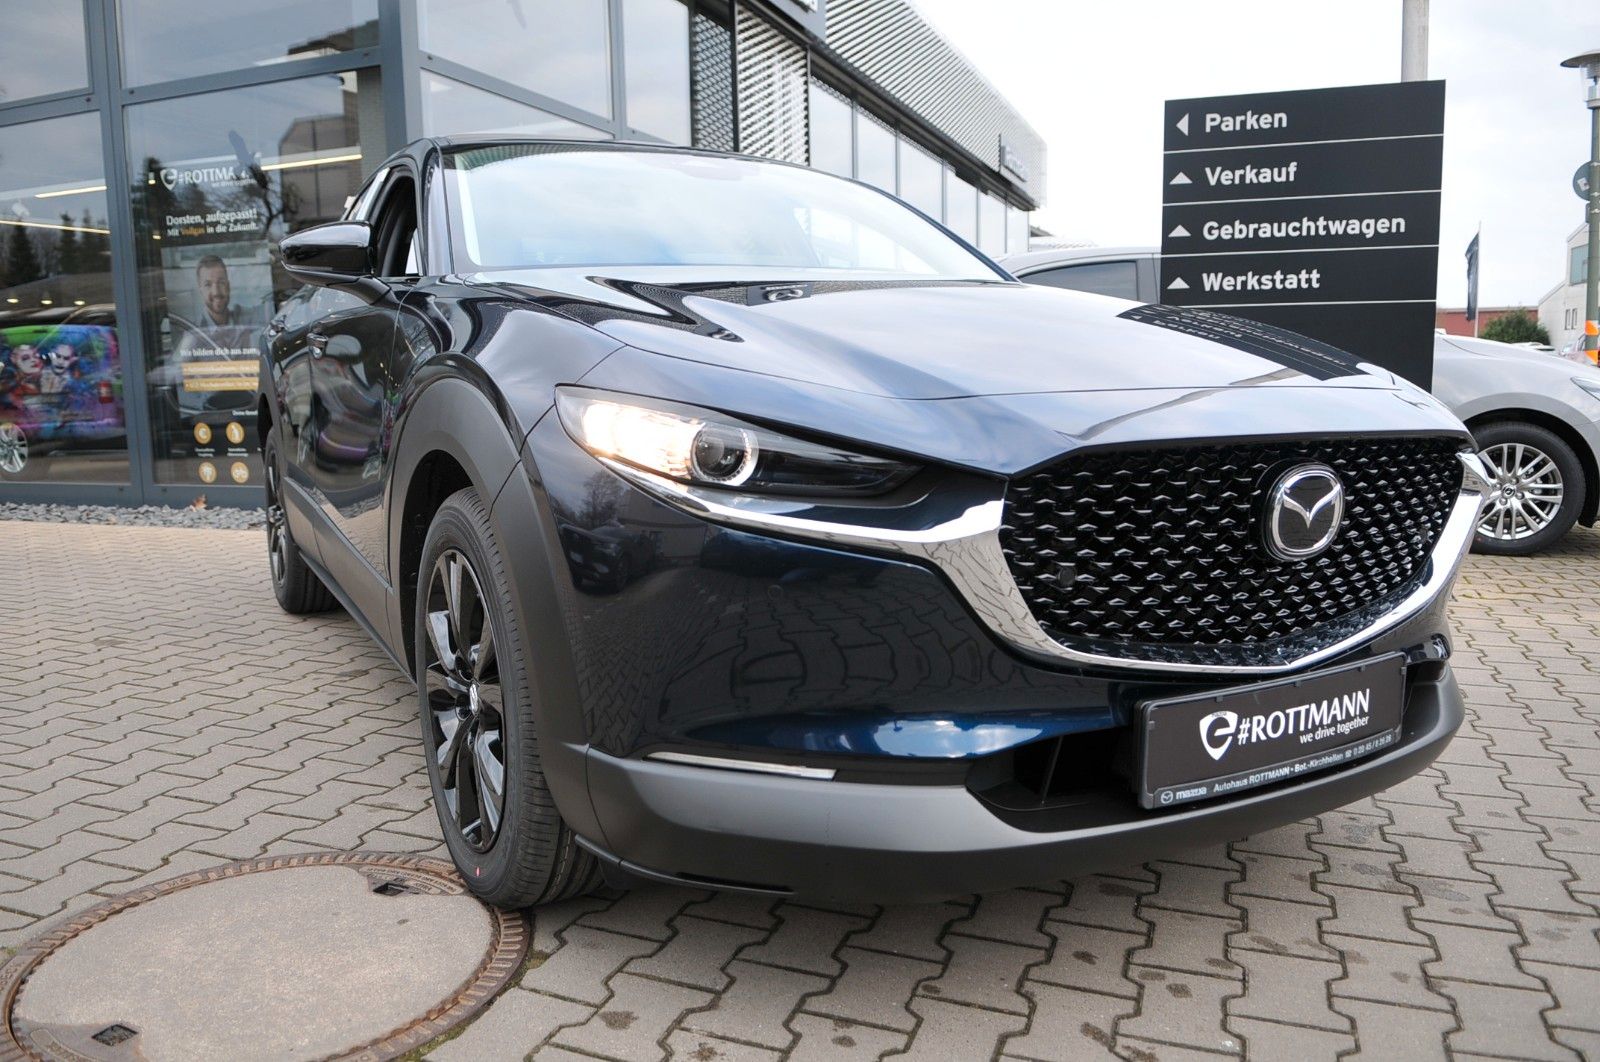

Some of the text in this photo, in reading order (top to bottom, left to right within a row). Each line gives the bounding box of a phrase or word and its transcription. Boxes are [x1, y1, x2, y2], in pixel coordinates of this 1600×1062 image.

[1205, 110, 1287, 132] Parken
[1205, 162, 1298, 186] Verkauf
[165, 207, 258, 226] Dorsten, aufgepasst!
[1202, 216, 1405, 240] Gebrauchtwagen
[1202, 269, 1320, 291] Werkstatt
[1237, 688, 1370, 746] #ROTTMANN
[1299, 715, 1370, 744] we drive together
[1175, 786, 1207, 800] mazda
[1213, 779, 1248, 793] Autohaus
[1249, 766, 1290, 784] ROTTMANN
